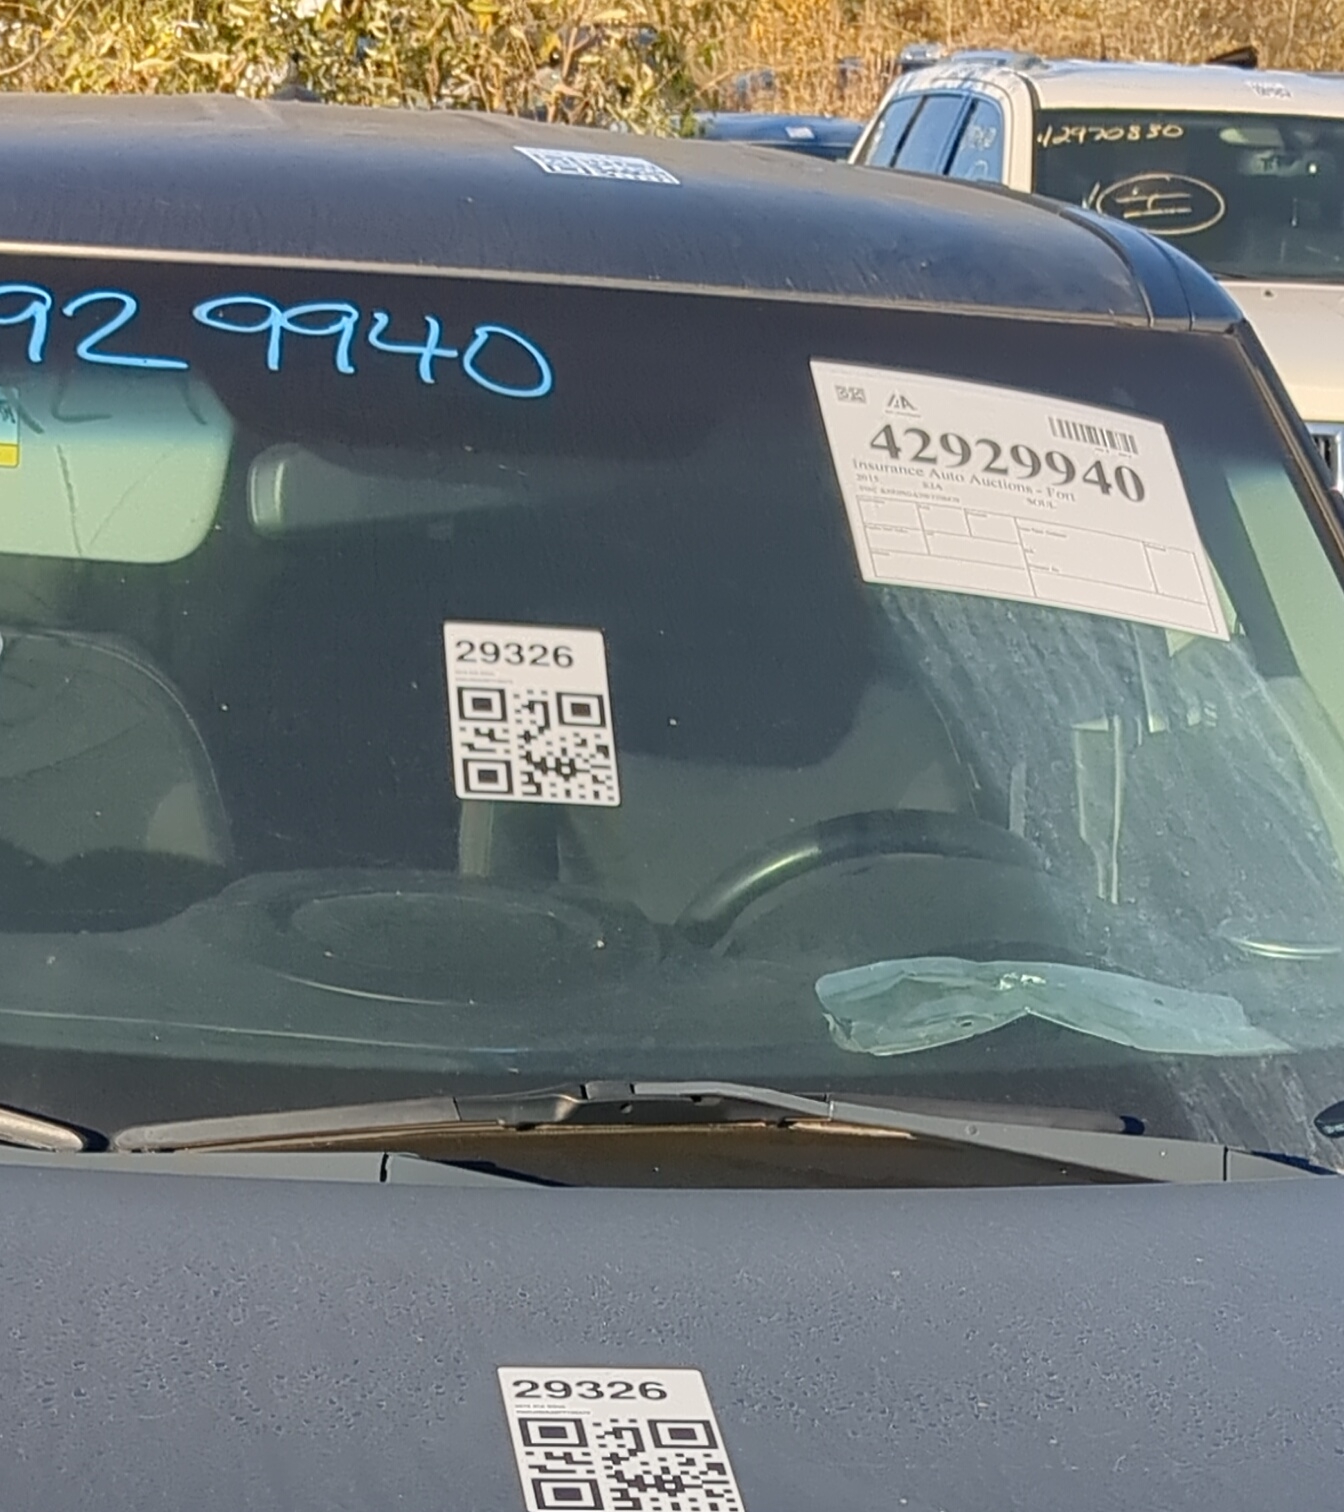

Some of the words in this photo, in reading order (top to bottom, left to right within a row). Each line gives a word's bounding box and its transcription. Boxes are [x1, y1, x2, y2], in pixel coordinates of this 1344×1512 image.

[853, 459, 925, 477] Insurance
[929, 466, 965, 483] Auto
[969, 473, 1034, 495] Auctions
[869, 423, 1146, 502] 42929940
[455, 639, 574, 668] 29326
[511, 1379, 669, 1400] 29326
